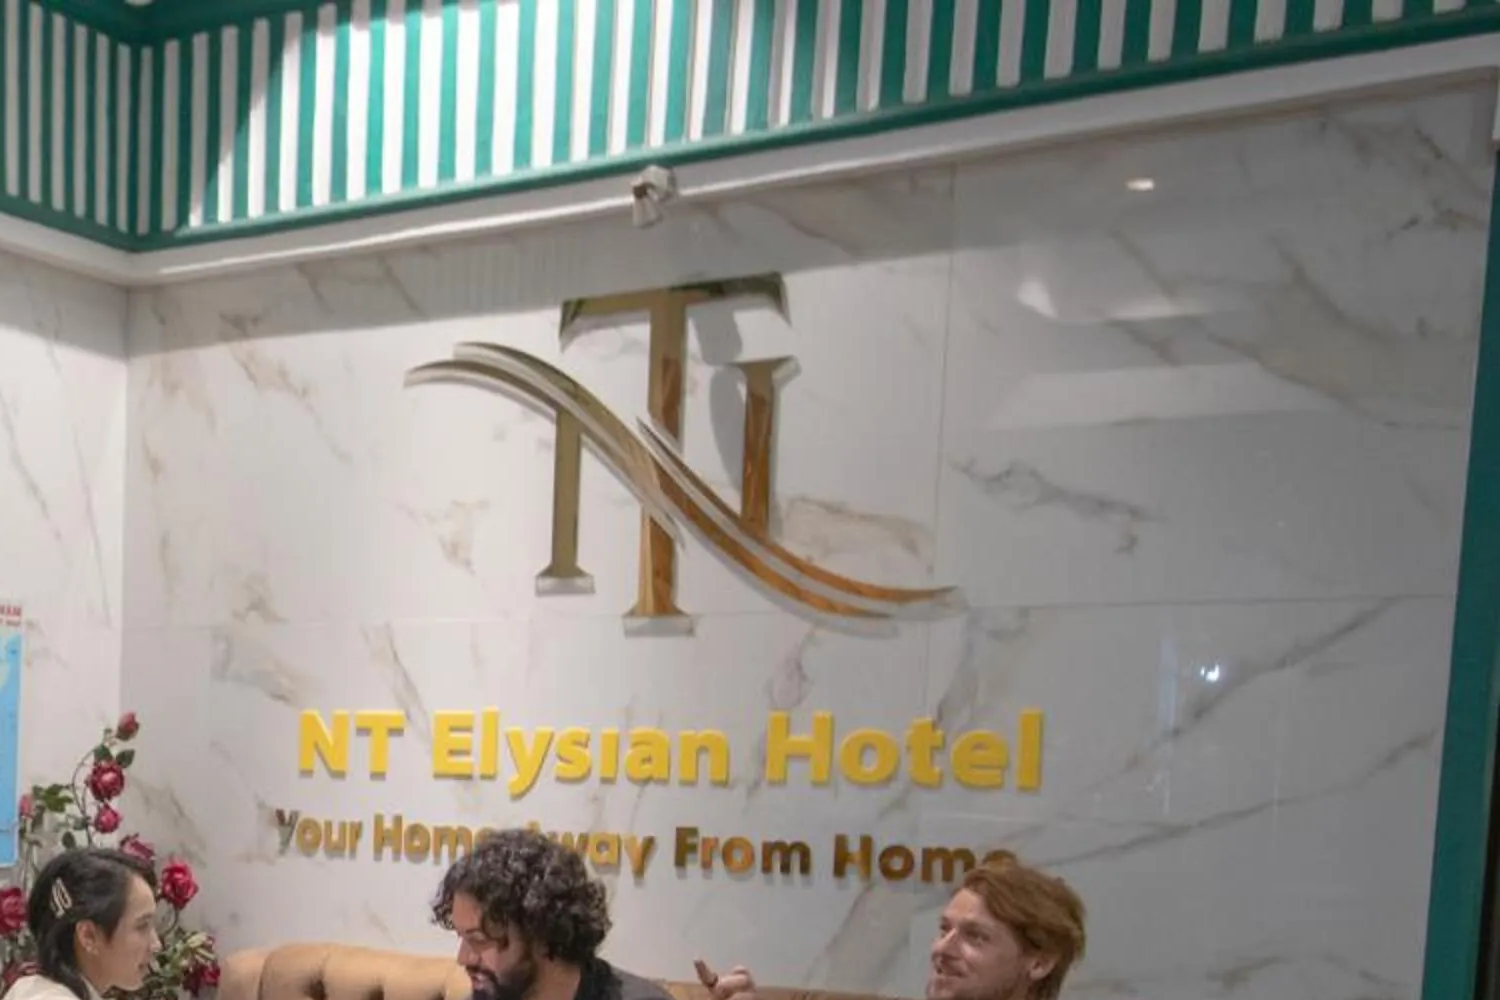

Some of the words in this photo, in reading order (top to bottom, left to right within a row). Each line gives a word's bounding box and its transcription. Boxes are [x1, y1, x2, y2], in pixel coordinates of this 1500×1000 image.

[299, 709, 405, 779] NT
[432, 705, 731, 800] Elysian
[765, 706, 1044, 793] Hotel
[275, 808, 363, 861] Your
[529, 820, 656, 882] way
[674, 826, 812, 878] From
